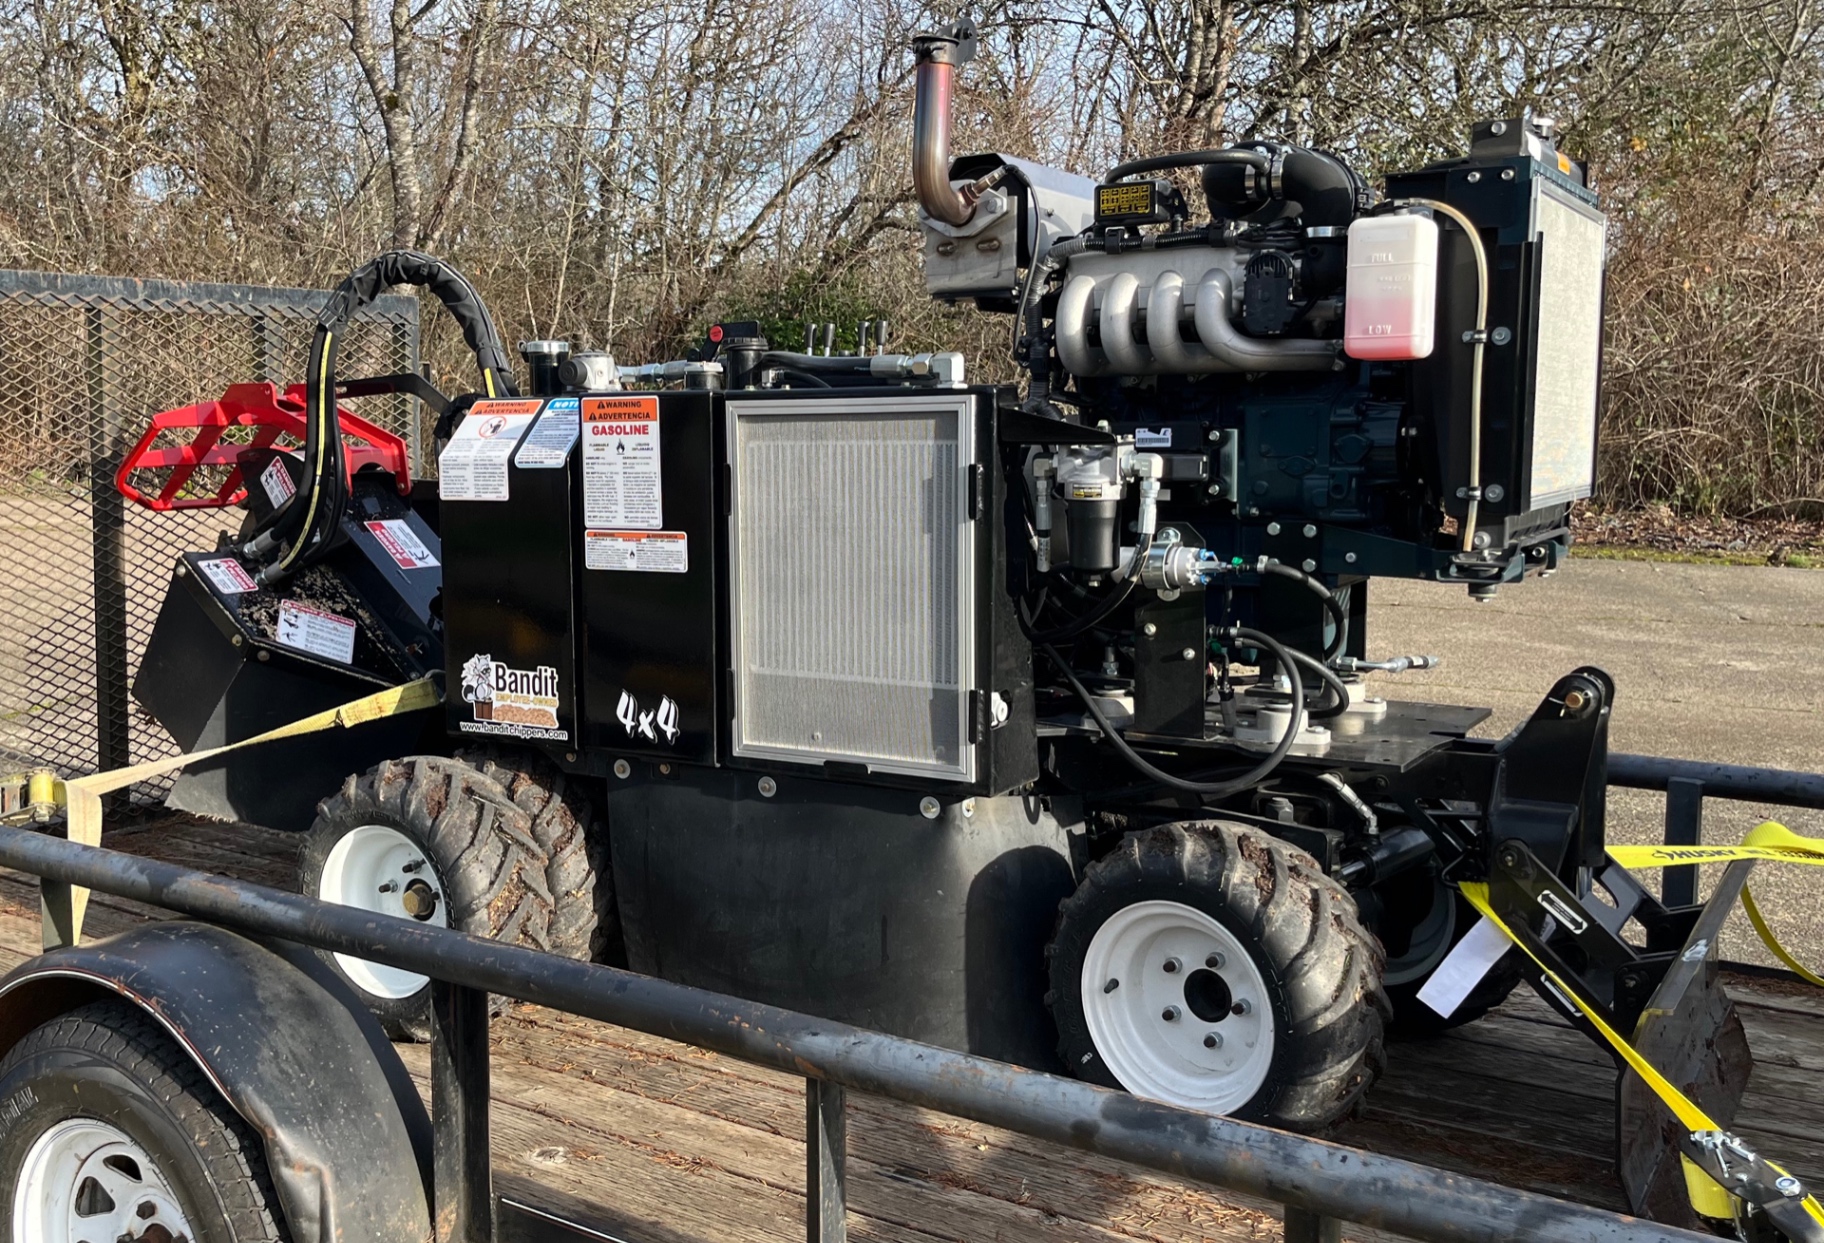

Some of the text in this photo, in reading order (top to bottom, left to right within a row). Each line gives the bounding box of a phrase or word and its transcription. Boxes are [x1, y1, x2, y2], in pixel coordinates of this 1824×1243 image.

[1371, 252, 1394, 263] FULL
[1368, 324, 1392, 335] LOW
[605, 400, 642, 408] WARNING
[598, 412, 651, 420] ADVERTENCIA
[591, 424, 649, 436] GASOLINE
[495, 663, 557, 698] Bandit
[615, 689, 680, 744] 4x4
[460, 721, 568, 740] www.banditchippers.com
[1672, 849, 1737, 859] HUSKY
